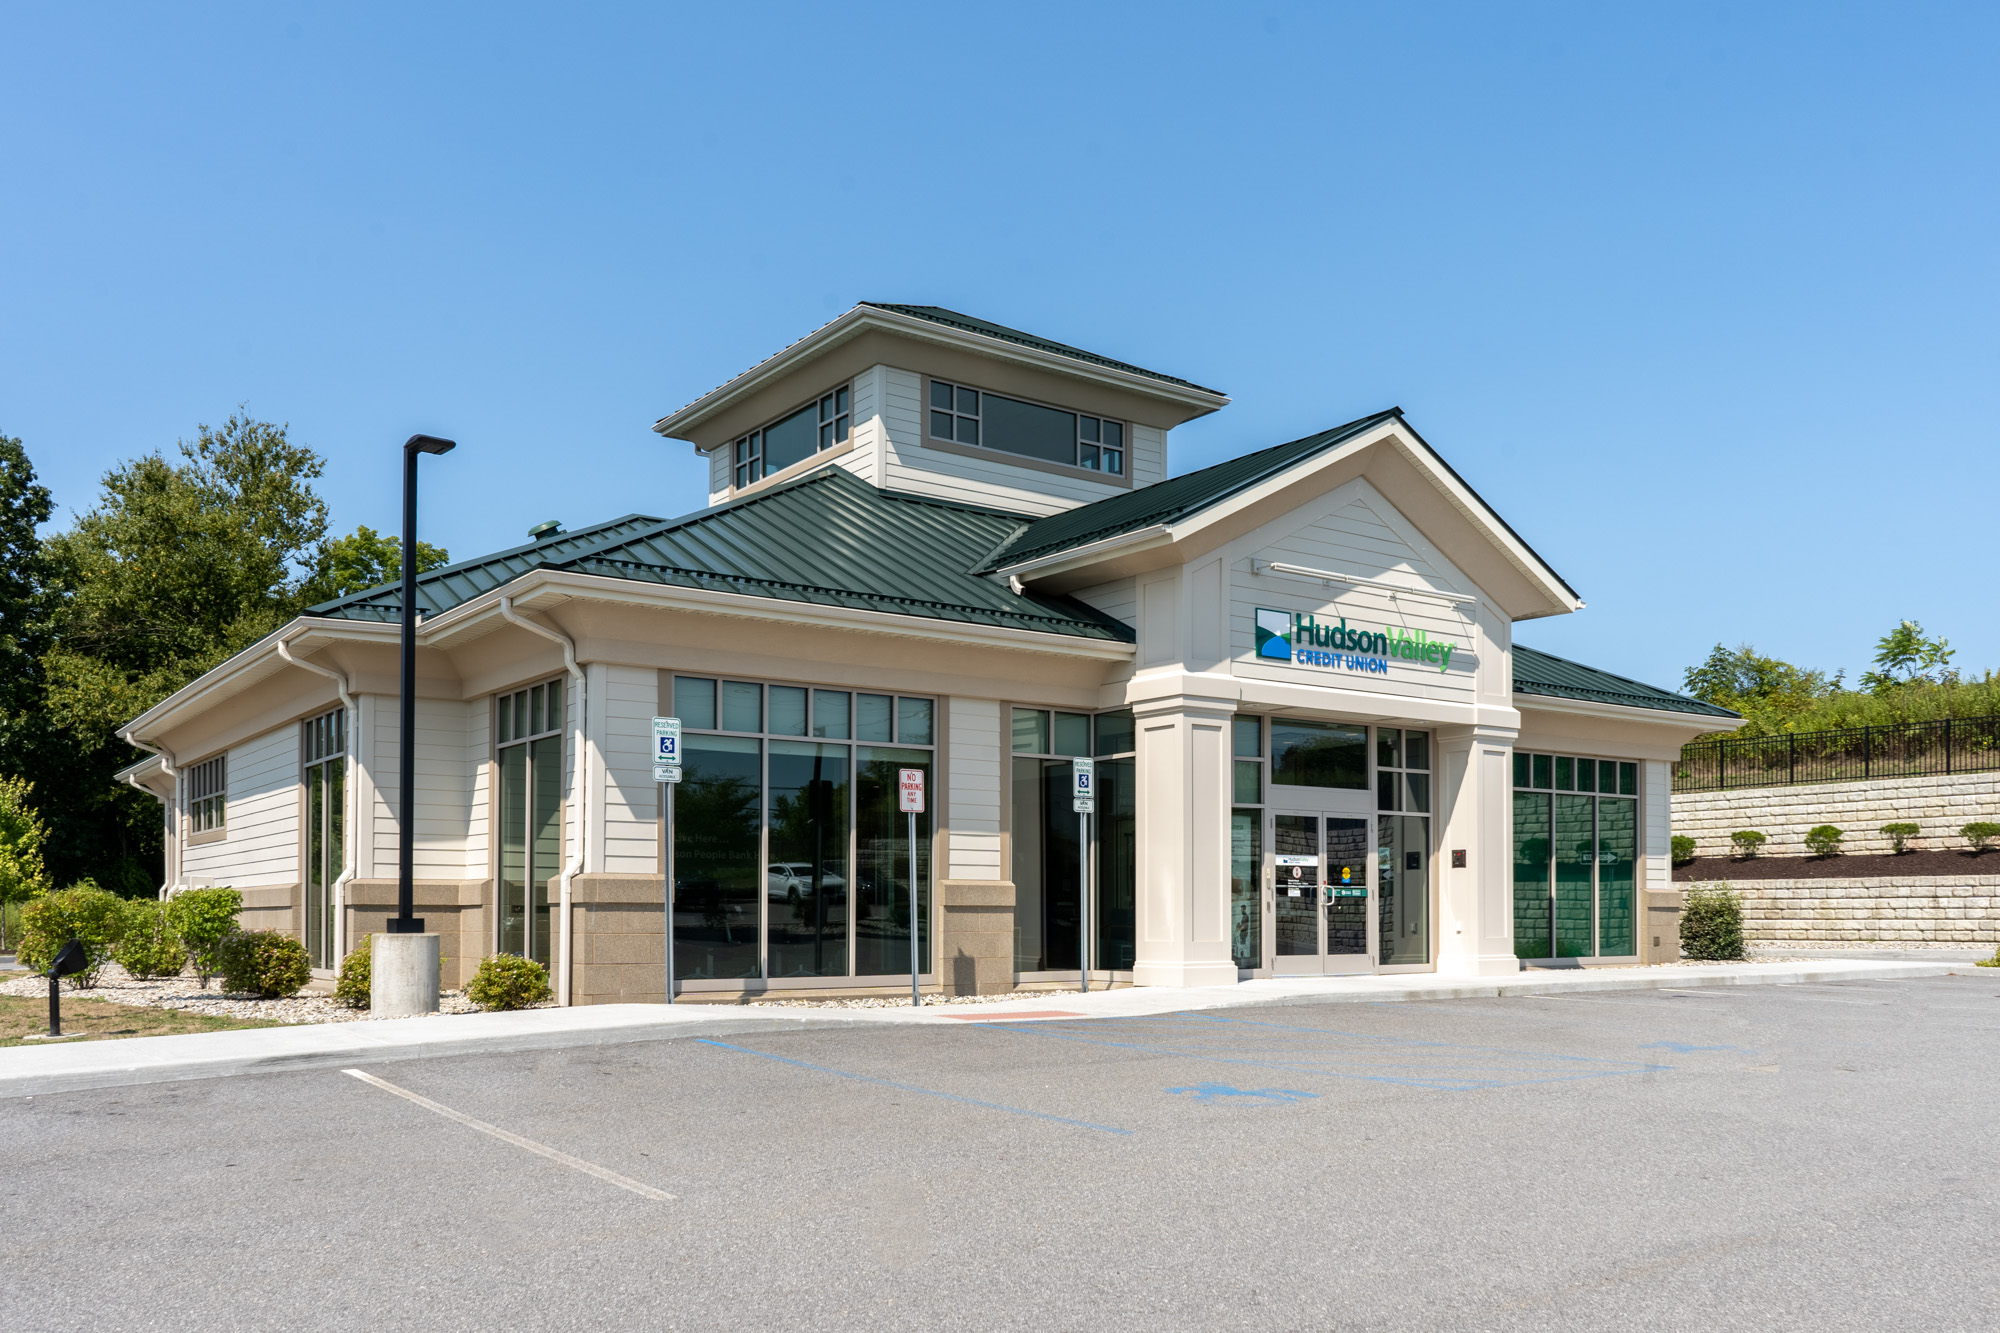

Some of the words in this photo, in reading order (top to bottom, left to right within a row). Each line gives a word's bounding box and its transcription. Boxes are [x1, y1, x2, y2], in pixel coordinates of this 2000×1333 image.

[1297, 649, 1342, 668] CREDIT
[1346, 655, 1387, 675] UNION
[655, 721, 679, 729] RESERVED
[656, 729, 678, 737] PARKING
[906, 773, 916, 781] NO
[901, 782, 922, 791] PARKING
[694, 849, 727, 860] People
[729, 850, 752, 860] Bank
